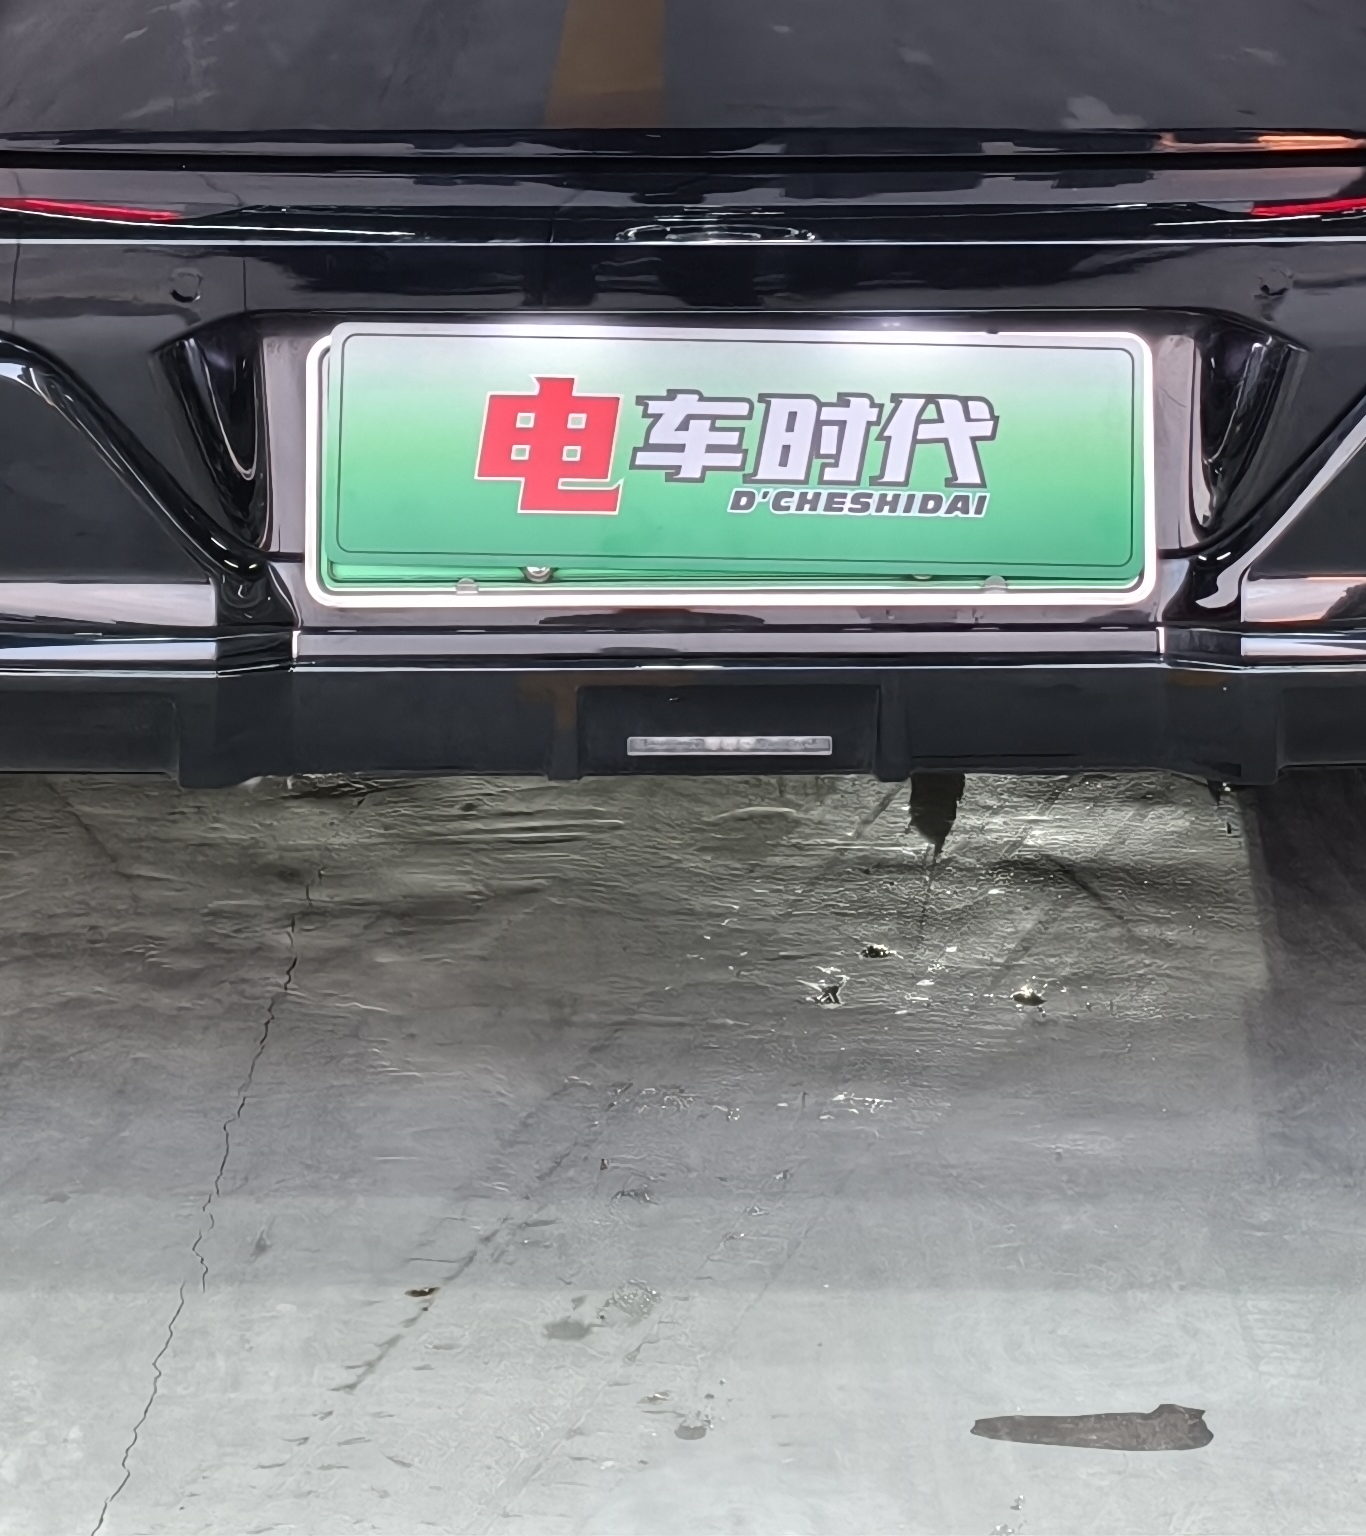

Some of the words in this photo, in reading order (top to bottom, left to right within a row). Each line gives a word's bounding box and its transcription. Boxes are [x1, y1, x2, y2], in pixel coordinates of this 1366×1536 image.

[474, 374, 1000, 515] 电车时代
[727, 487, 990, 518] D'CHESHIDAI
